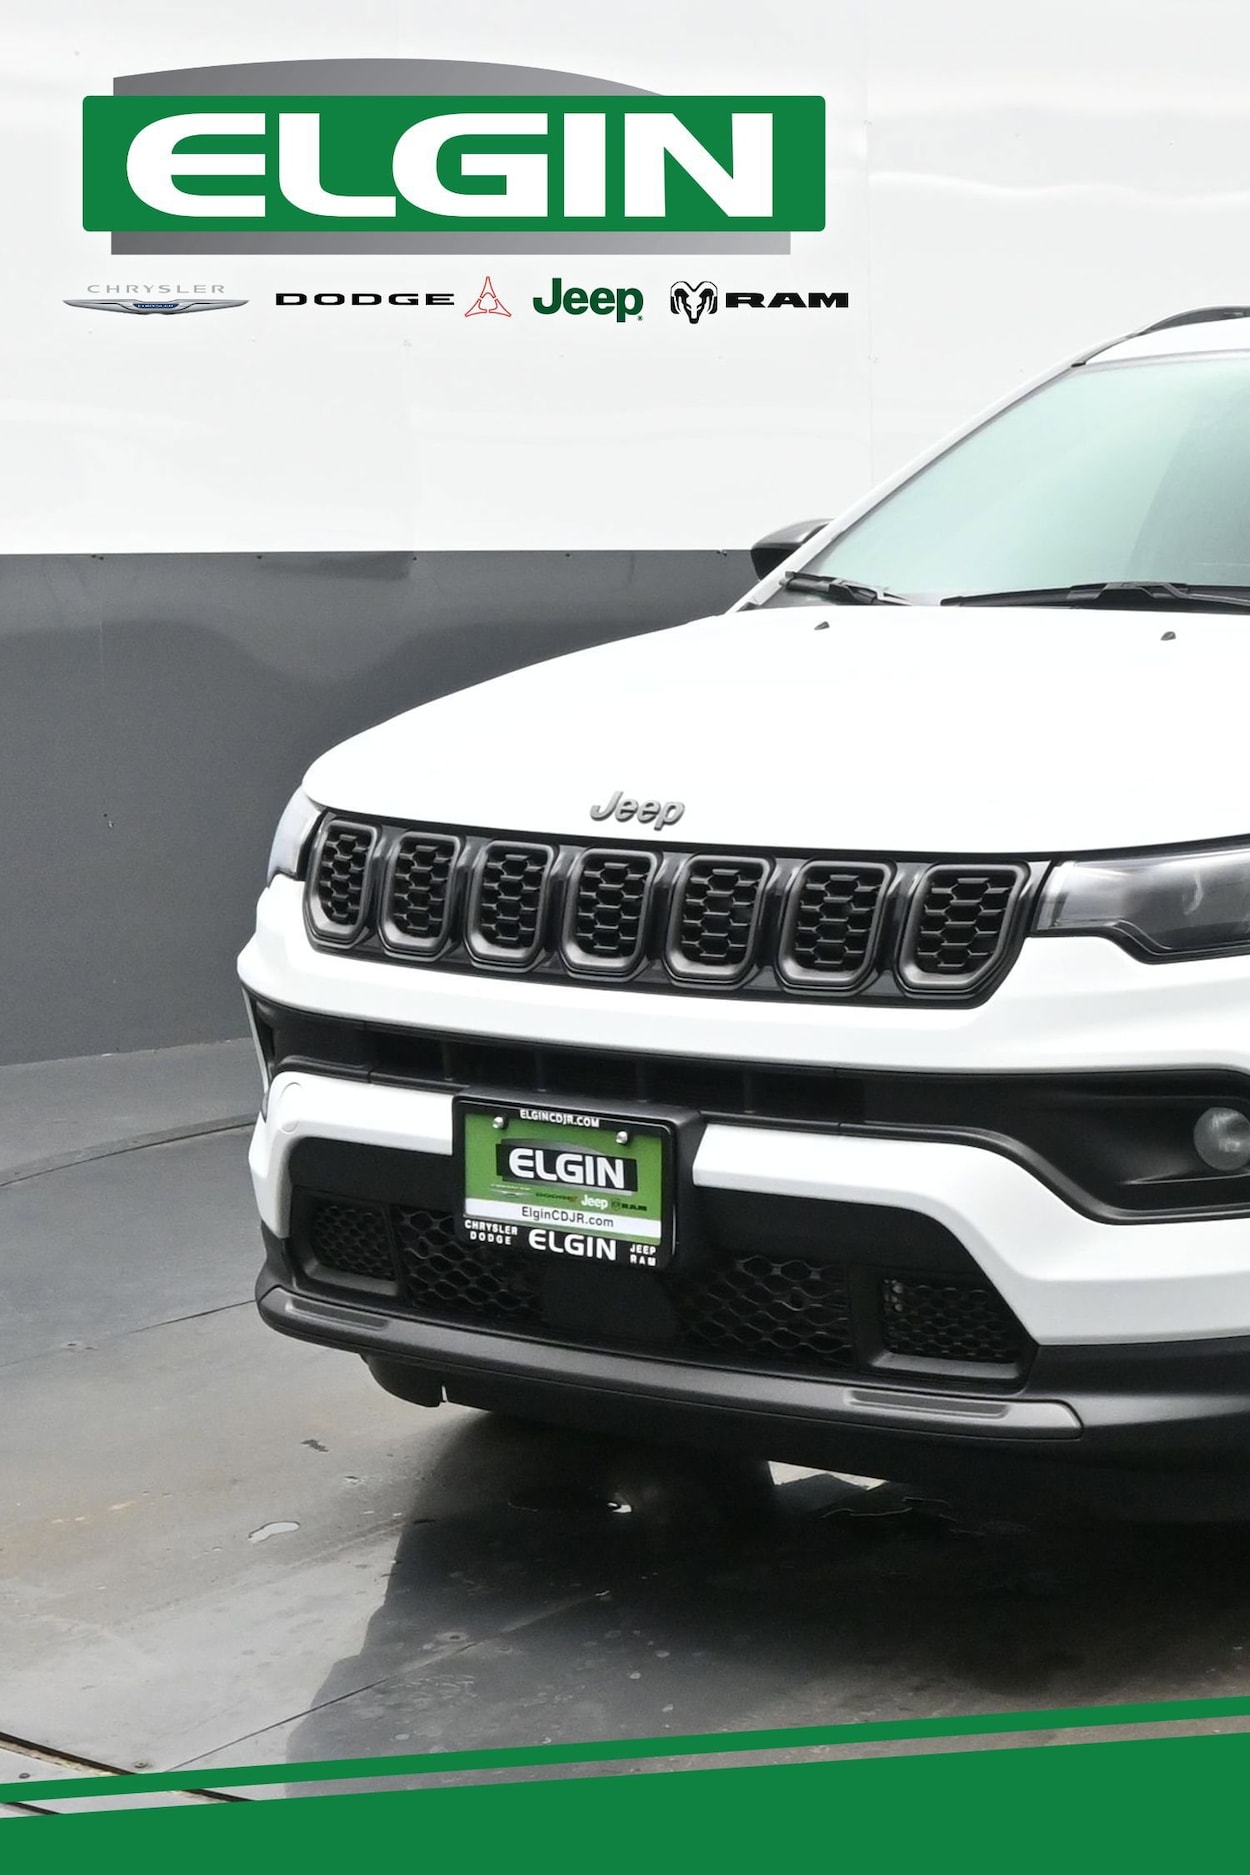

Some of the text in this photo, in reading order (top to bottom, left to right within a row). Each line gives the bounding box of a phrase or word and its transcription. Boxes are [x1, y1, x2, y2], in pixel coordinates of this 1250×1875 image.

[590, 790, 686, 831] Jeep
[519, 1109, 600, 1128] ELGINCDJR.COM
[508, 1147, 625, 1189] ELGIN
[580, 1194, 609, 1211] Jeep
[521, 1205, 614, 1228] ElginCDJR.com
[464, 1219, 518, 1236] CHRYSLER
[469, 1231, 512, 1246] DODGE
[528, 1228, 617, 1262] ELGIN
[629, 1244, 657, 1256] JEEP
[629, 1254, 657, 1267] RAM
